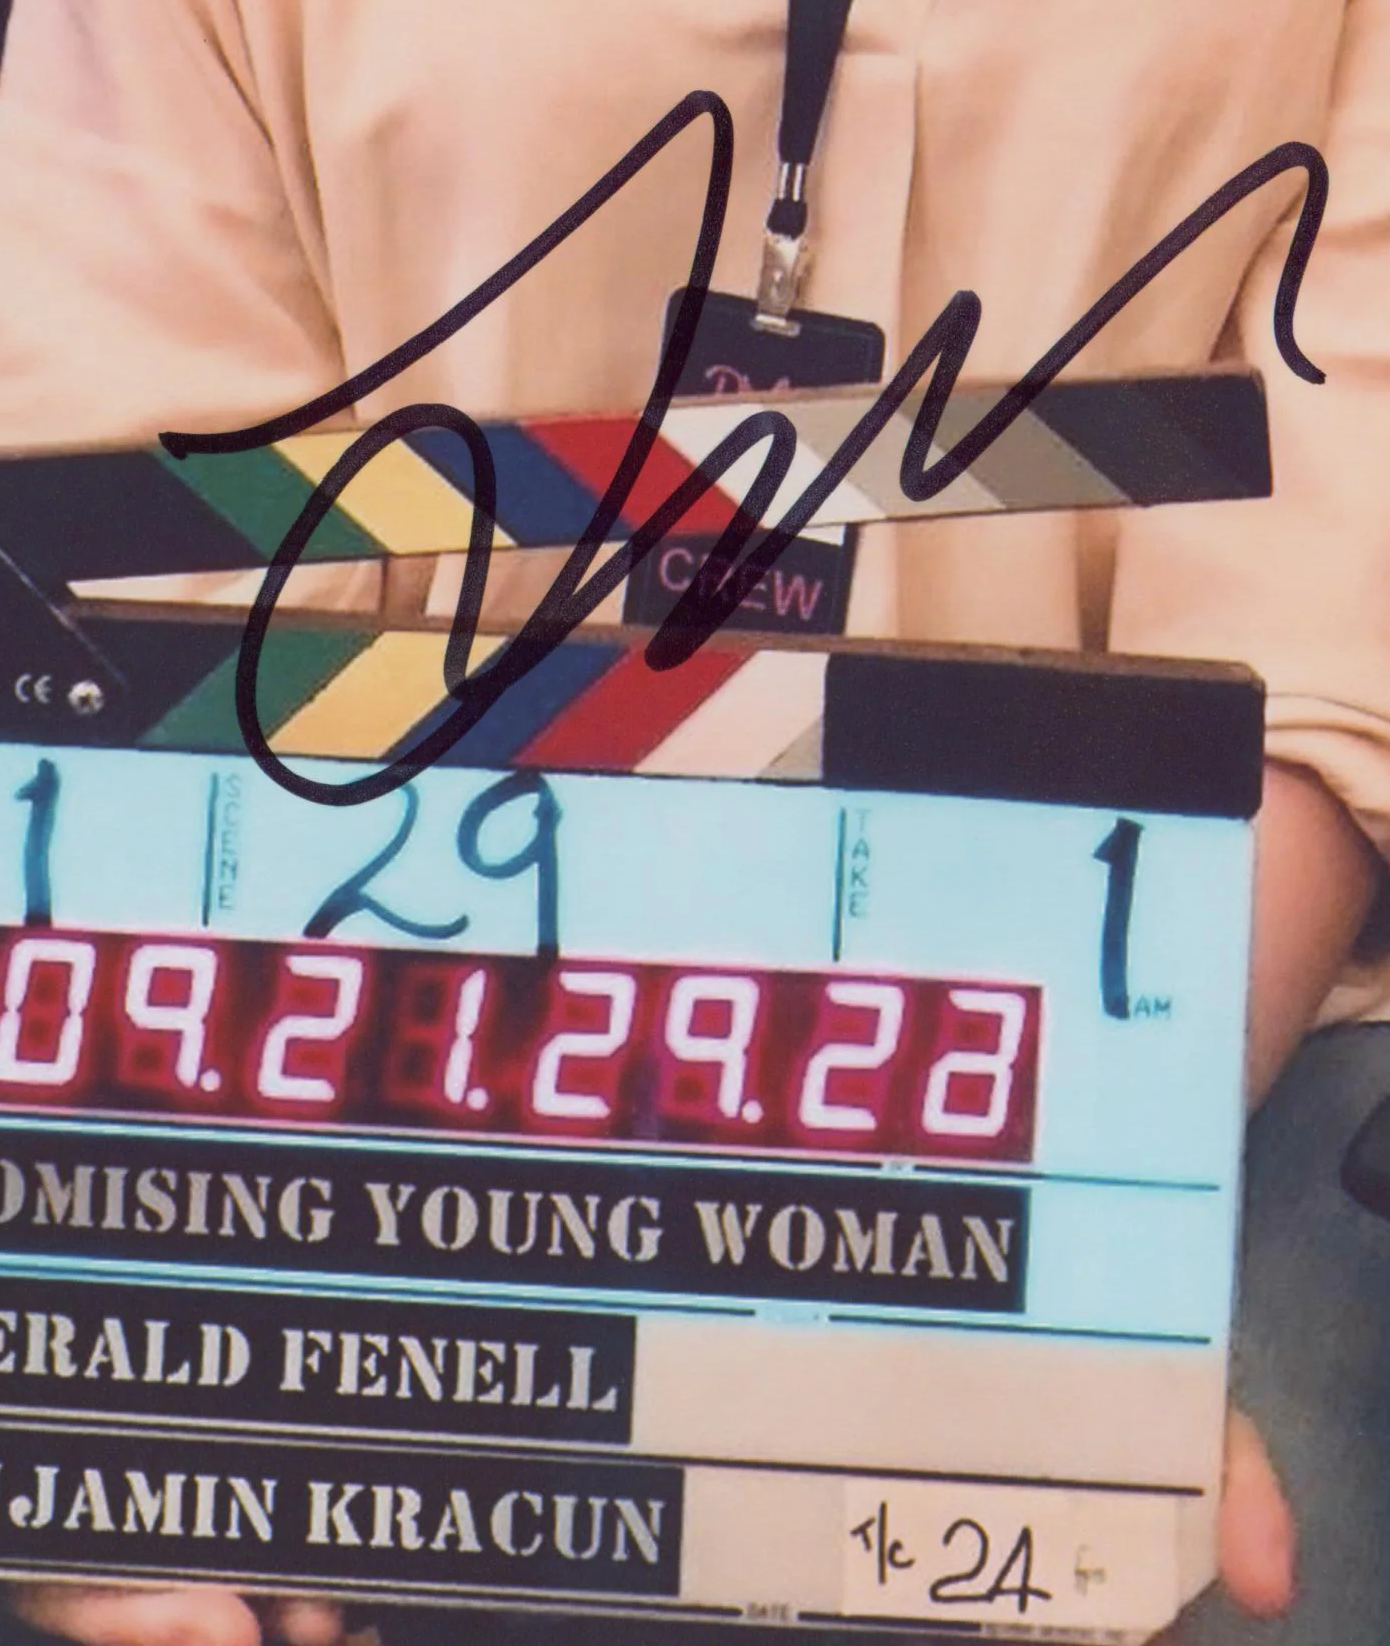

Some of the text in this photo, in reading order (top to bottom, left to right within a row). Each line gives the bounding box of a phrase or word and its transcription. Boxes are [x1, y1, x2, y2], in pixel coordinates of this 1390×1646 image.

[660, 547, 824, 620] CEW
[218, 773, 243, 911] SCENE
[302, 772, 563, 959] 29
[849, 807, 873, 919] TAKE
[1092, 816, 1144, 1021] 1
[364, 1181, 664, 1263] YOUNG
[693, 1200, 1015, 1284] WOMAN
[278, 1327, 618, 1412] FENELL
[305, 1480, 665, 1565] KRACUN
[928, 1517, 1053, 1615] 24
